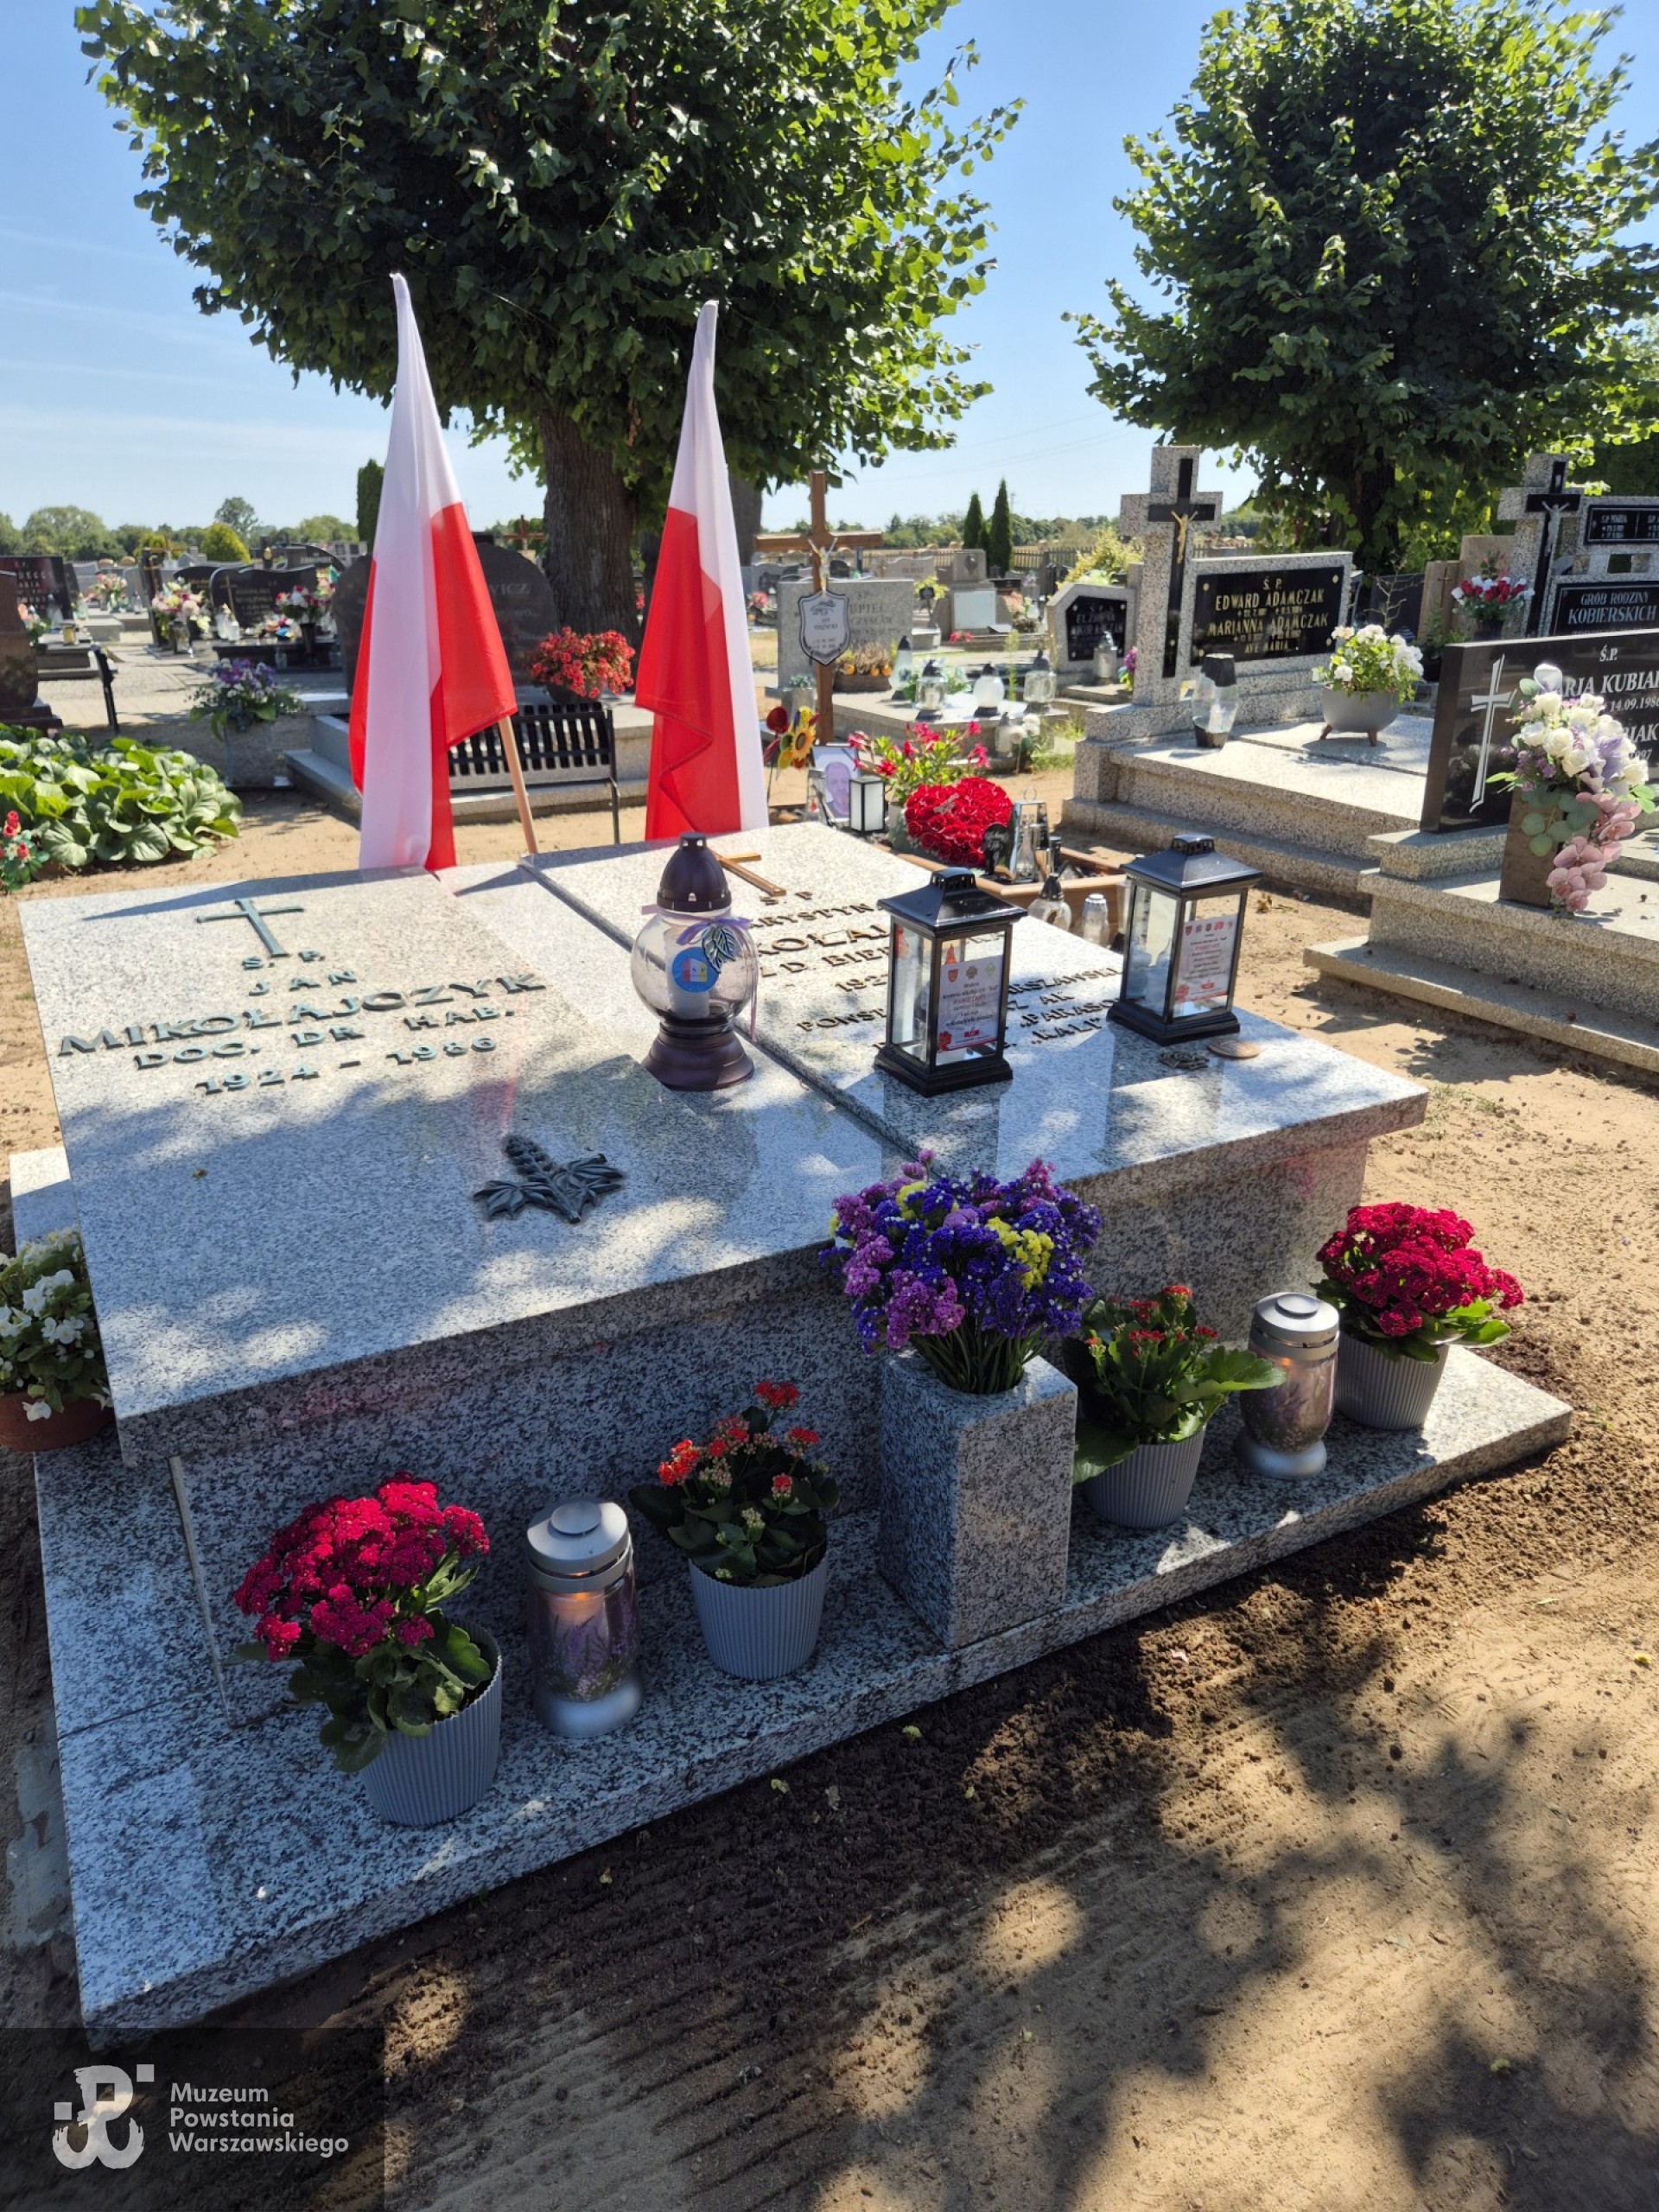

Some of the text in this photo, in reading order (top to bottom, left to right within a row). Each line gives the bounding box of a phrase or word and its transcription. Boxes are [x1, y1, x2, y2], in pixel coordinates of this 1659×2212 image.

[1215, 593, 1260, 612] EDWARD
[1265, 588, 1325, 608] ADAMCZAK
[1580, 591, 1649, 605] GRÓB RODZINY
[1206, 617, 1263, 637] MARIANNA
[1269, 613, 1329, 633] ADAMCZAK
[1567, 605, 1657, 626] KOBIERSKICH
[248, 970, 358, 996] JAN
[58, 973, 547, 1058] MIKOŁAJCZYK
[133, 1005, 515, 1070] DOC. DR HAB.
[194, 1063, 321, 1096] 1924
[385, 1036, 497, 1065] 1986
